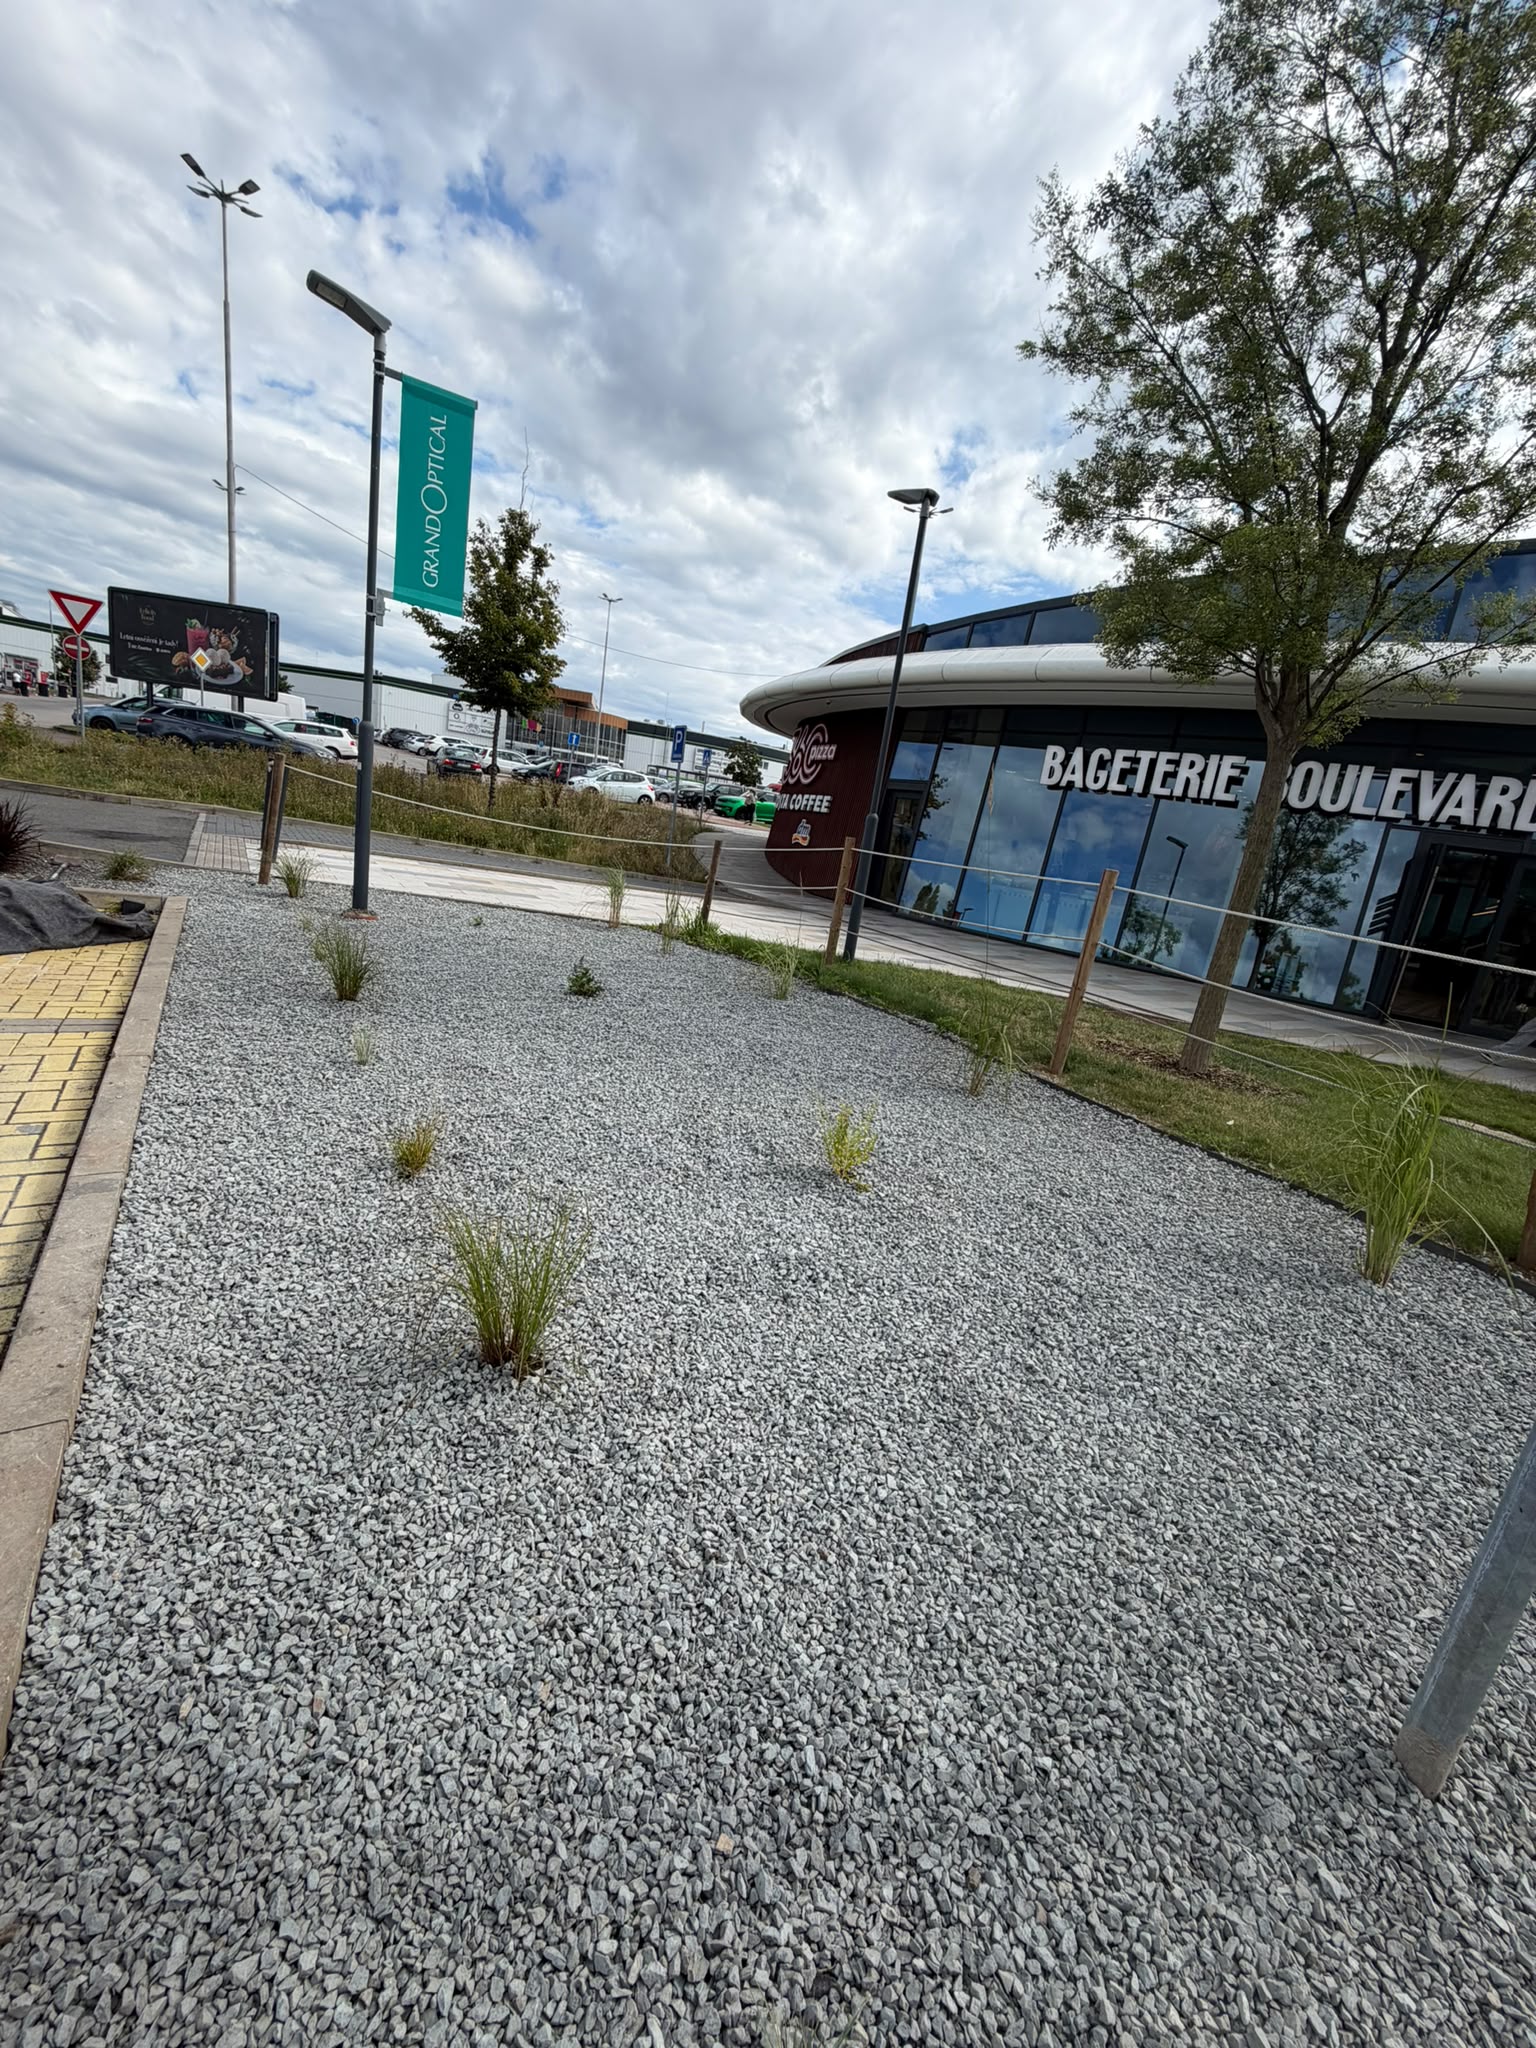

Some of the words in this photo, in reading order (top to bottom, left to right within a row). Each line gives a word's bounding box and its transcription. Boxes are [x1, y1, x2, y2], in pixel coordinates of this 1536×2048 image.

[420, 414, 448, 588] GRANDOPTICAL
[674, 730, 683, 751] P
[808, 743, 837, 764] pizza
[1040, 745, 1247, 803] BAGETERIE
[789, 793, 832, 813] COFFEE
[1281, 761, 1536, 832] OULEVAR
